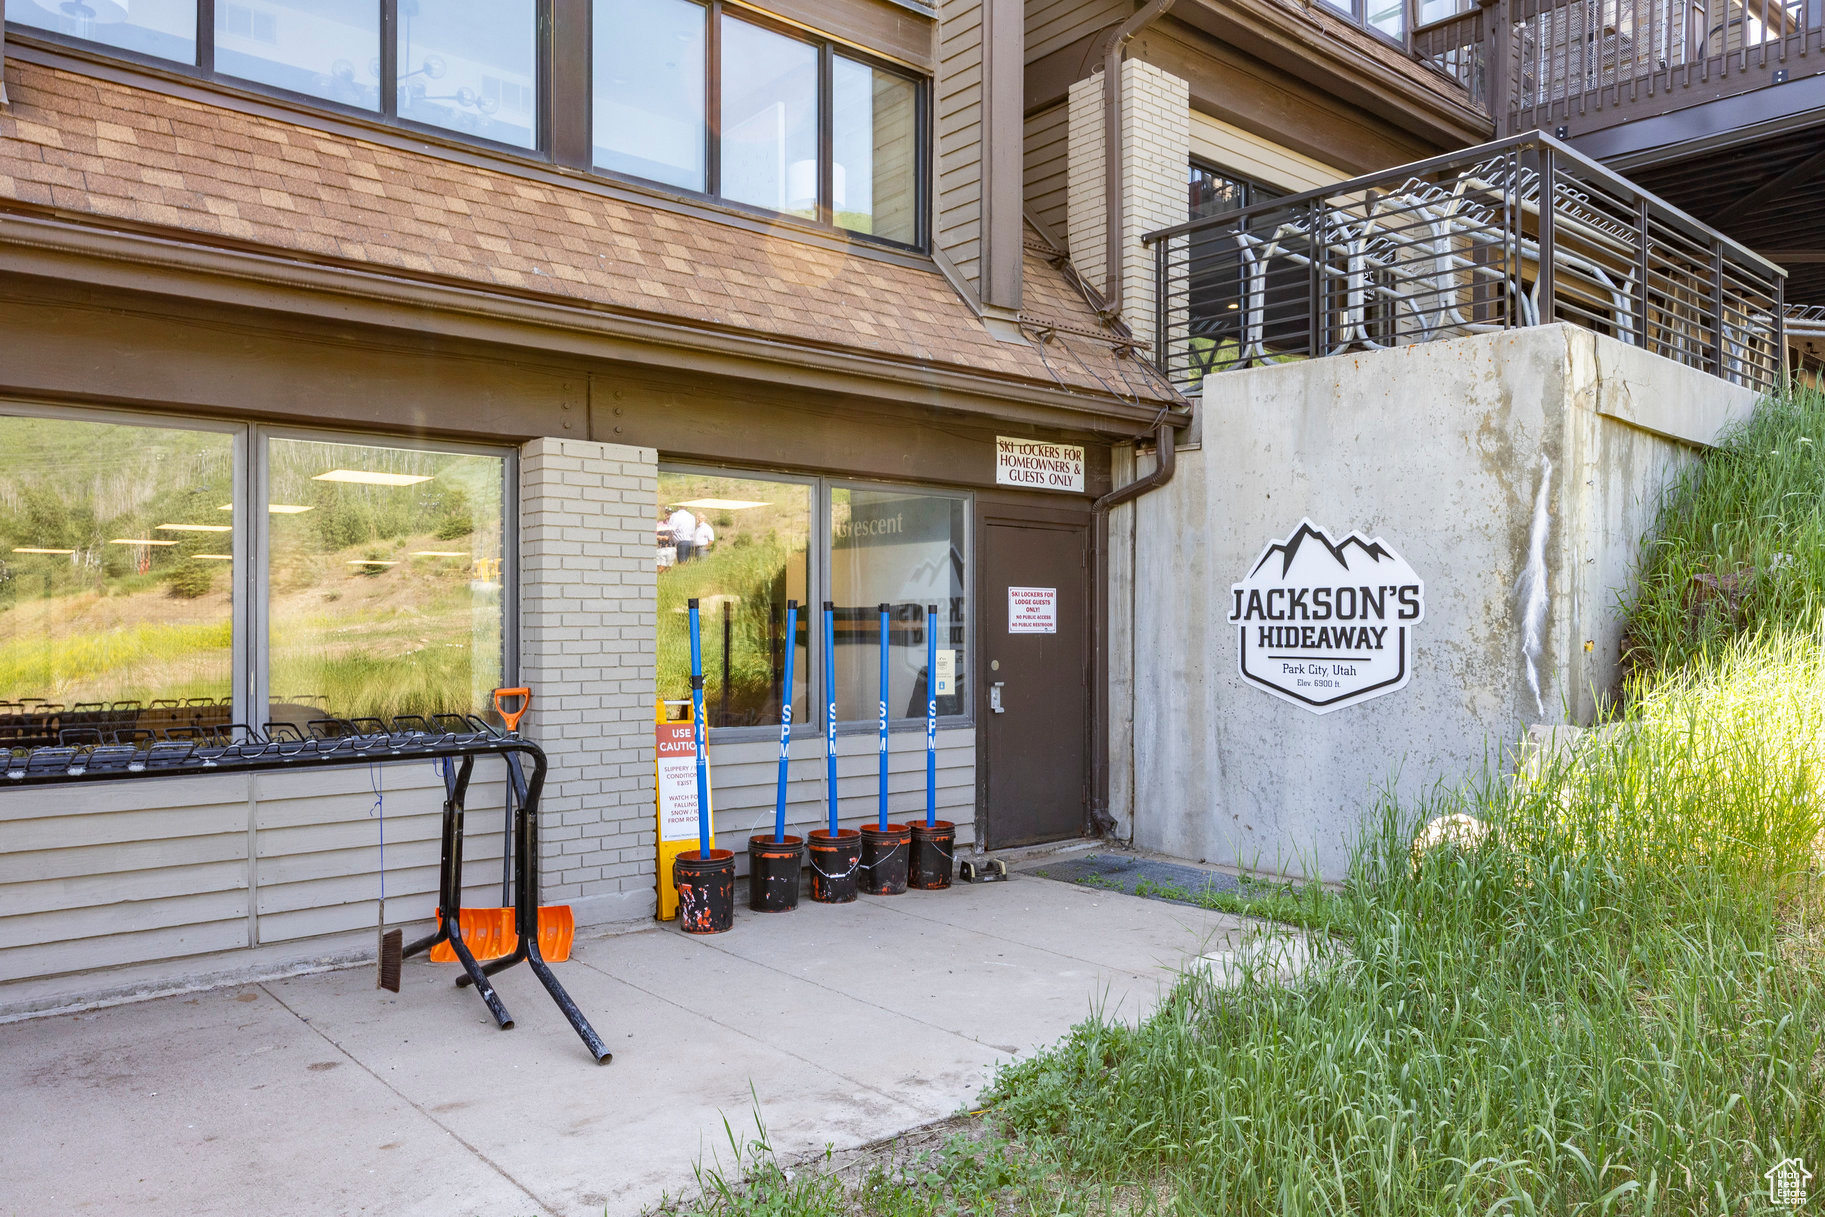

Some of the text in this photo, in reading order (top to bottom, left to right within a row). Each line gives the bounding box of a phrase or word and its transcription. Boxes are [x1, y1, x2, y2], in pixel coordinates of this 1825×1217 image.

[1000, 440, 1082, 462] SKI LOCKERS FOR
[1000, 454, 1081, 475] HOMEOWNERS &
[1009, 468, 1074, 486] GUESTS ONLY
[1230, 585, 1420, 620] JACKSON'S
[1258, 626, 1388, 650] HIDEAWAY
[1282, 663, 1356, 677] Park City, Utah
[1297, 679, 1312, 687] Elev.
[1314, 680, 1332, 688] 6900
[672, 728, 691, 738] USE
[659, 741, 697, 752] CAUTIO
